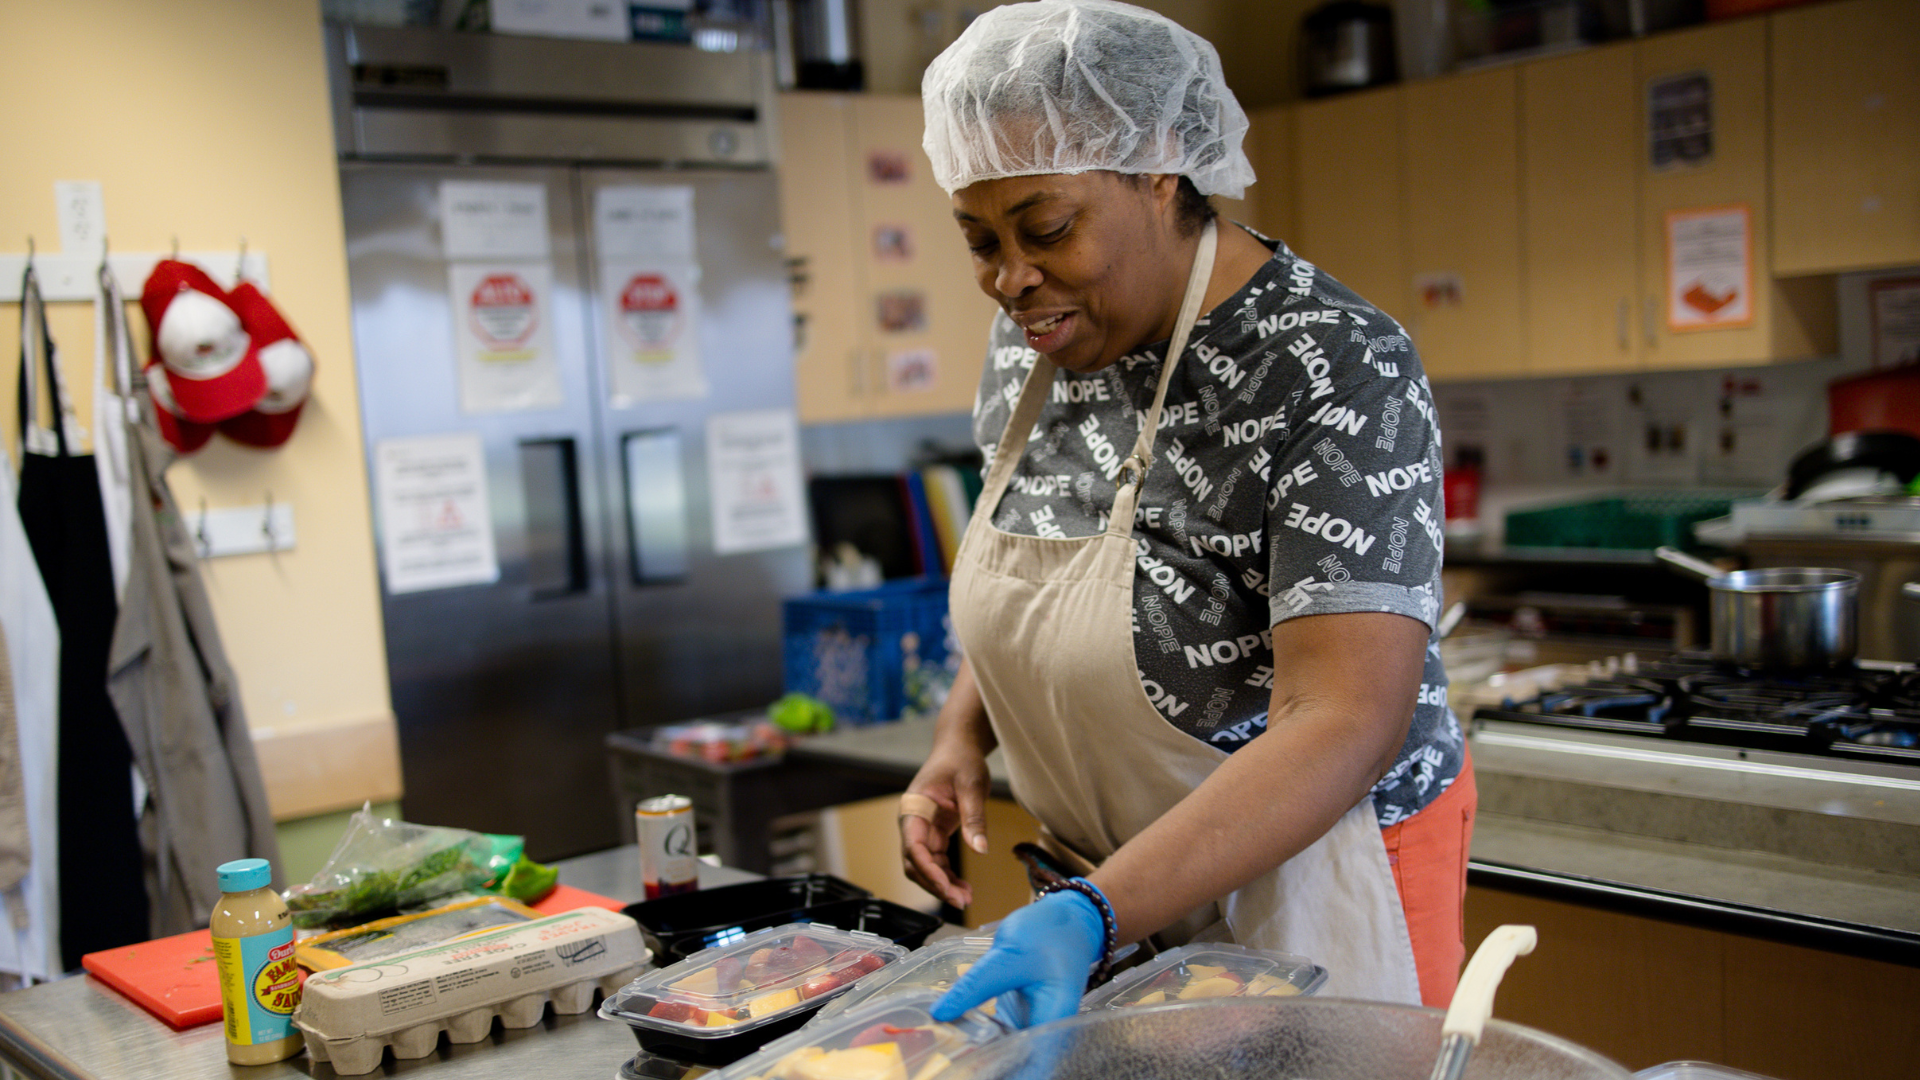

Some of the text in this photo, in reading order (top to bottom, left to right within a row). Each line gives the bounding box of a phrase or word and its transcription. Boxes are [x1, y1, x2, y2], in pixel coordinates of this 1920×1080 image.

[1241, 300, 1258, 334] PE
[1257, 310, 1341, 339] NOPE
[1190, 335, 1247, 390] NOP
[1238, 351, 1277, 404] NOPE
[1287, 332, 1335, 400] NOPE
[1053, 379, 1111, 404] NOPE
[1198, 385, 1221, 436] NOPE
[1078, 413, 1124, 482] NOPE
[1223, 405, 1287, 447] NOPE
[1375, 395, 1402, 452] NOPE
[1012, 475, 1072, 497] NOPE
[1165, 437, 1213, 503] NOPE
[1266, 460, 1318, 511] OPE
[1313, 437, 1362, 487] NOPE
[1364, 457, 1432, 497] NOPE
[1207, 467, 1242, 522] NOPE
[1284, 502, 1376, 556] NOPE
[1382, 516, 1410, 574] NOPE
[1413, 498, 1444, 553] OPE
[1317, 553, 1354, 584] NO
[1142, 595, 1181, 653] NOPE
[1200, 573, 1230, 626] NOPE
[1196, 687, 1234, 728] NOPE
[1415, 745, 1444, 796] OPE
[664, 823, 691, 856] Q
[266, 957, 298, 984] FAMO
[271, 944, 294, 961] Durk
